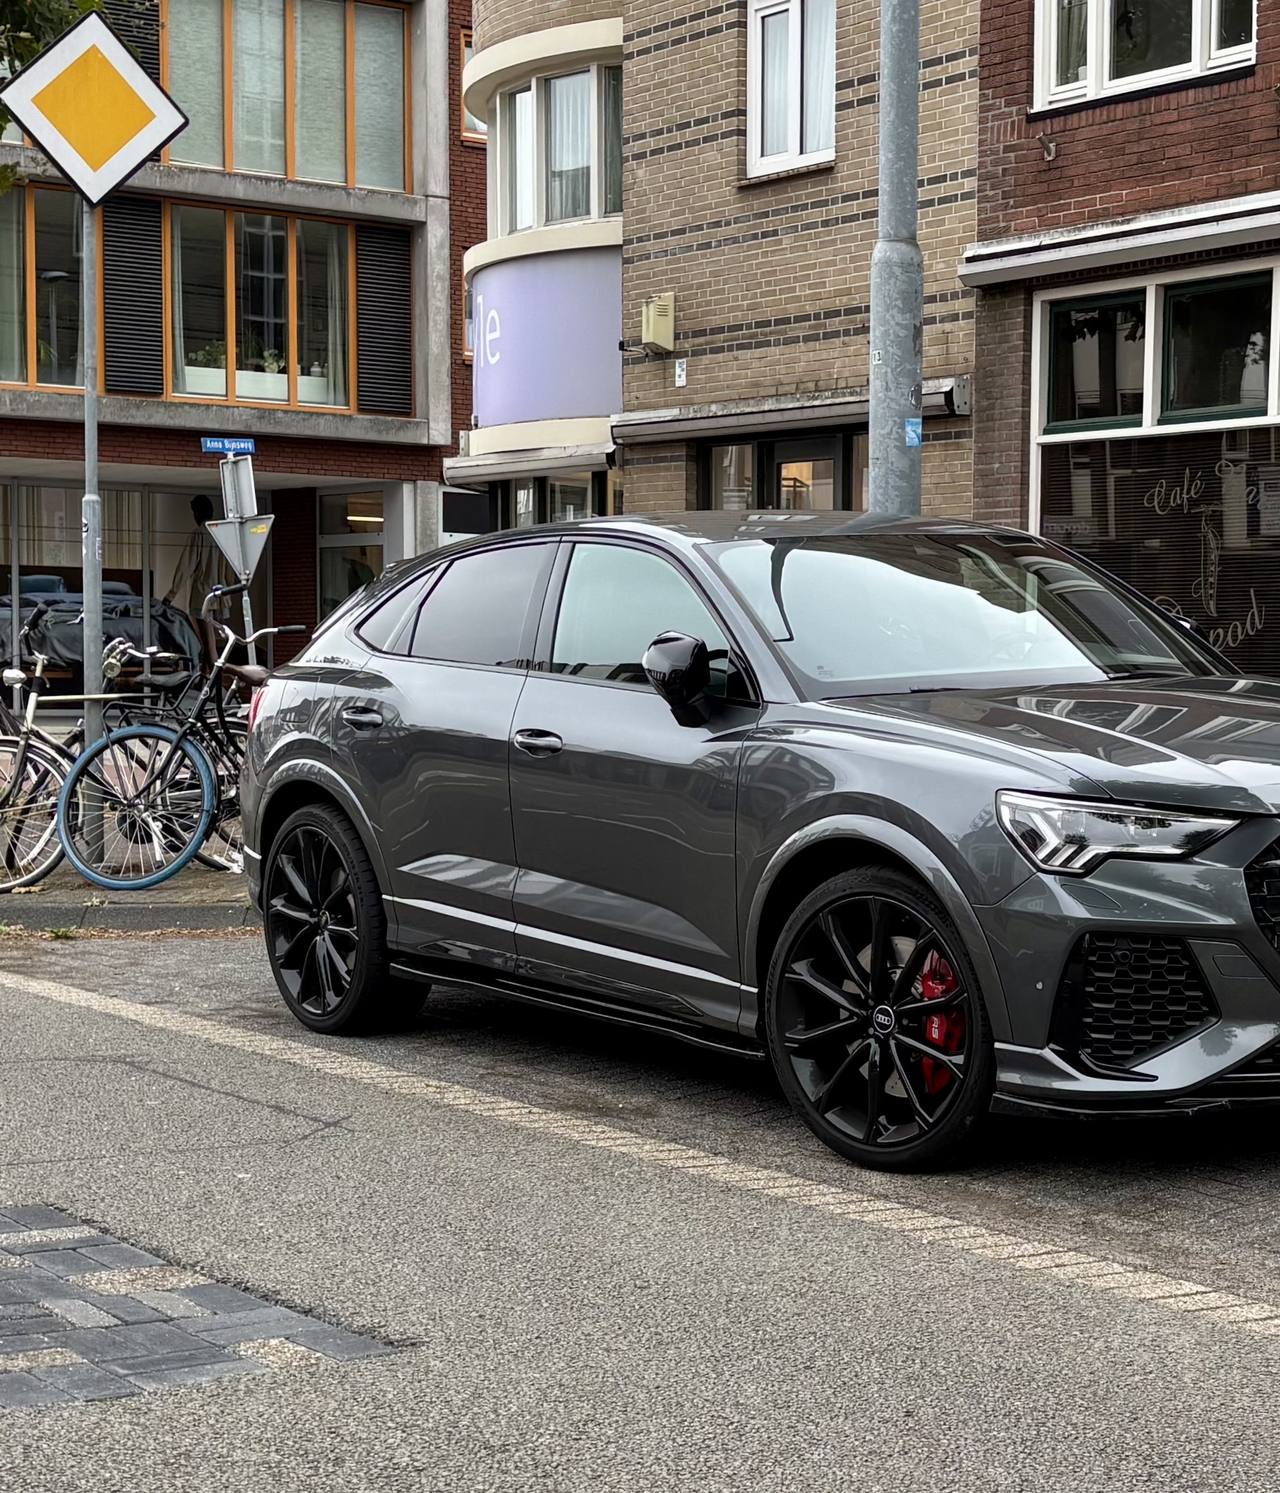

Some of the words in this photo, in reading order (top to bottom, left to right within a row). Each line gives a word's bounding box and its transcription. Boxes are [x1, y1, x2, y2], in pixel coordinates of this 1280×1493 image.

[475, 294, 500, 368] le
[207, 439, 222, 449] Anna
[1144, 467, 1204, 514] Café
[931, 1015, 939, 1039] RS
